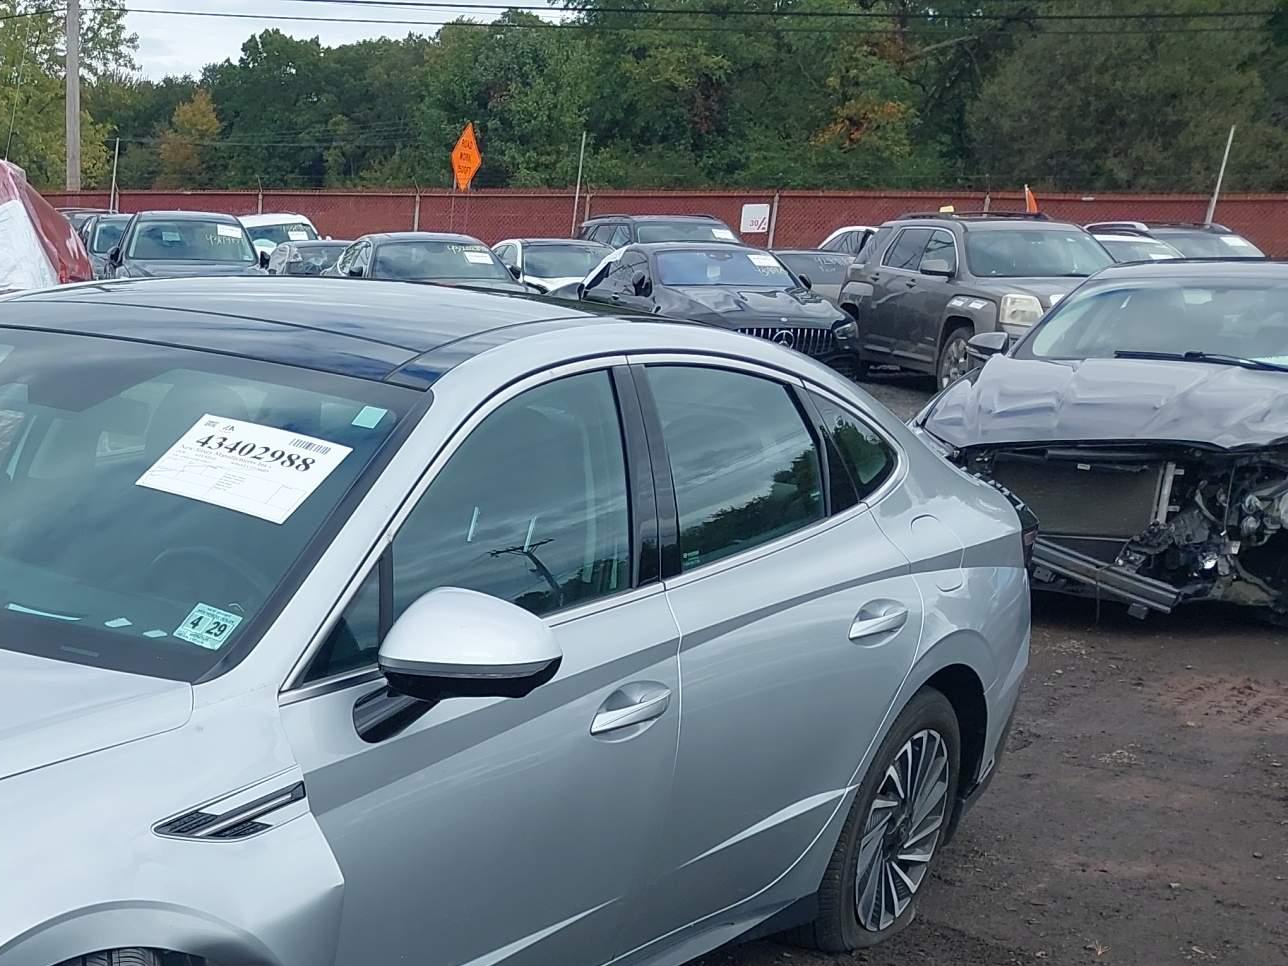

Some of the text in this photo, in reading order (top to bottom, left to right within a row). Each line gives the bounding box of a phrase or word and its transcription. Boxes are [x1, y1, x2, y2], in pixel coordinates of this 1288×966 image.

[196, 434, 316, 473] 43402988
[190, 615, 204, 629] 4
[205, 621, 228, 638] 29
